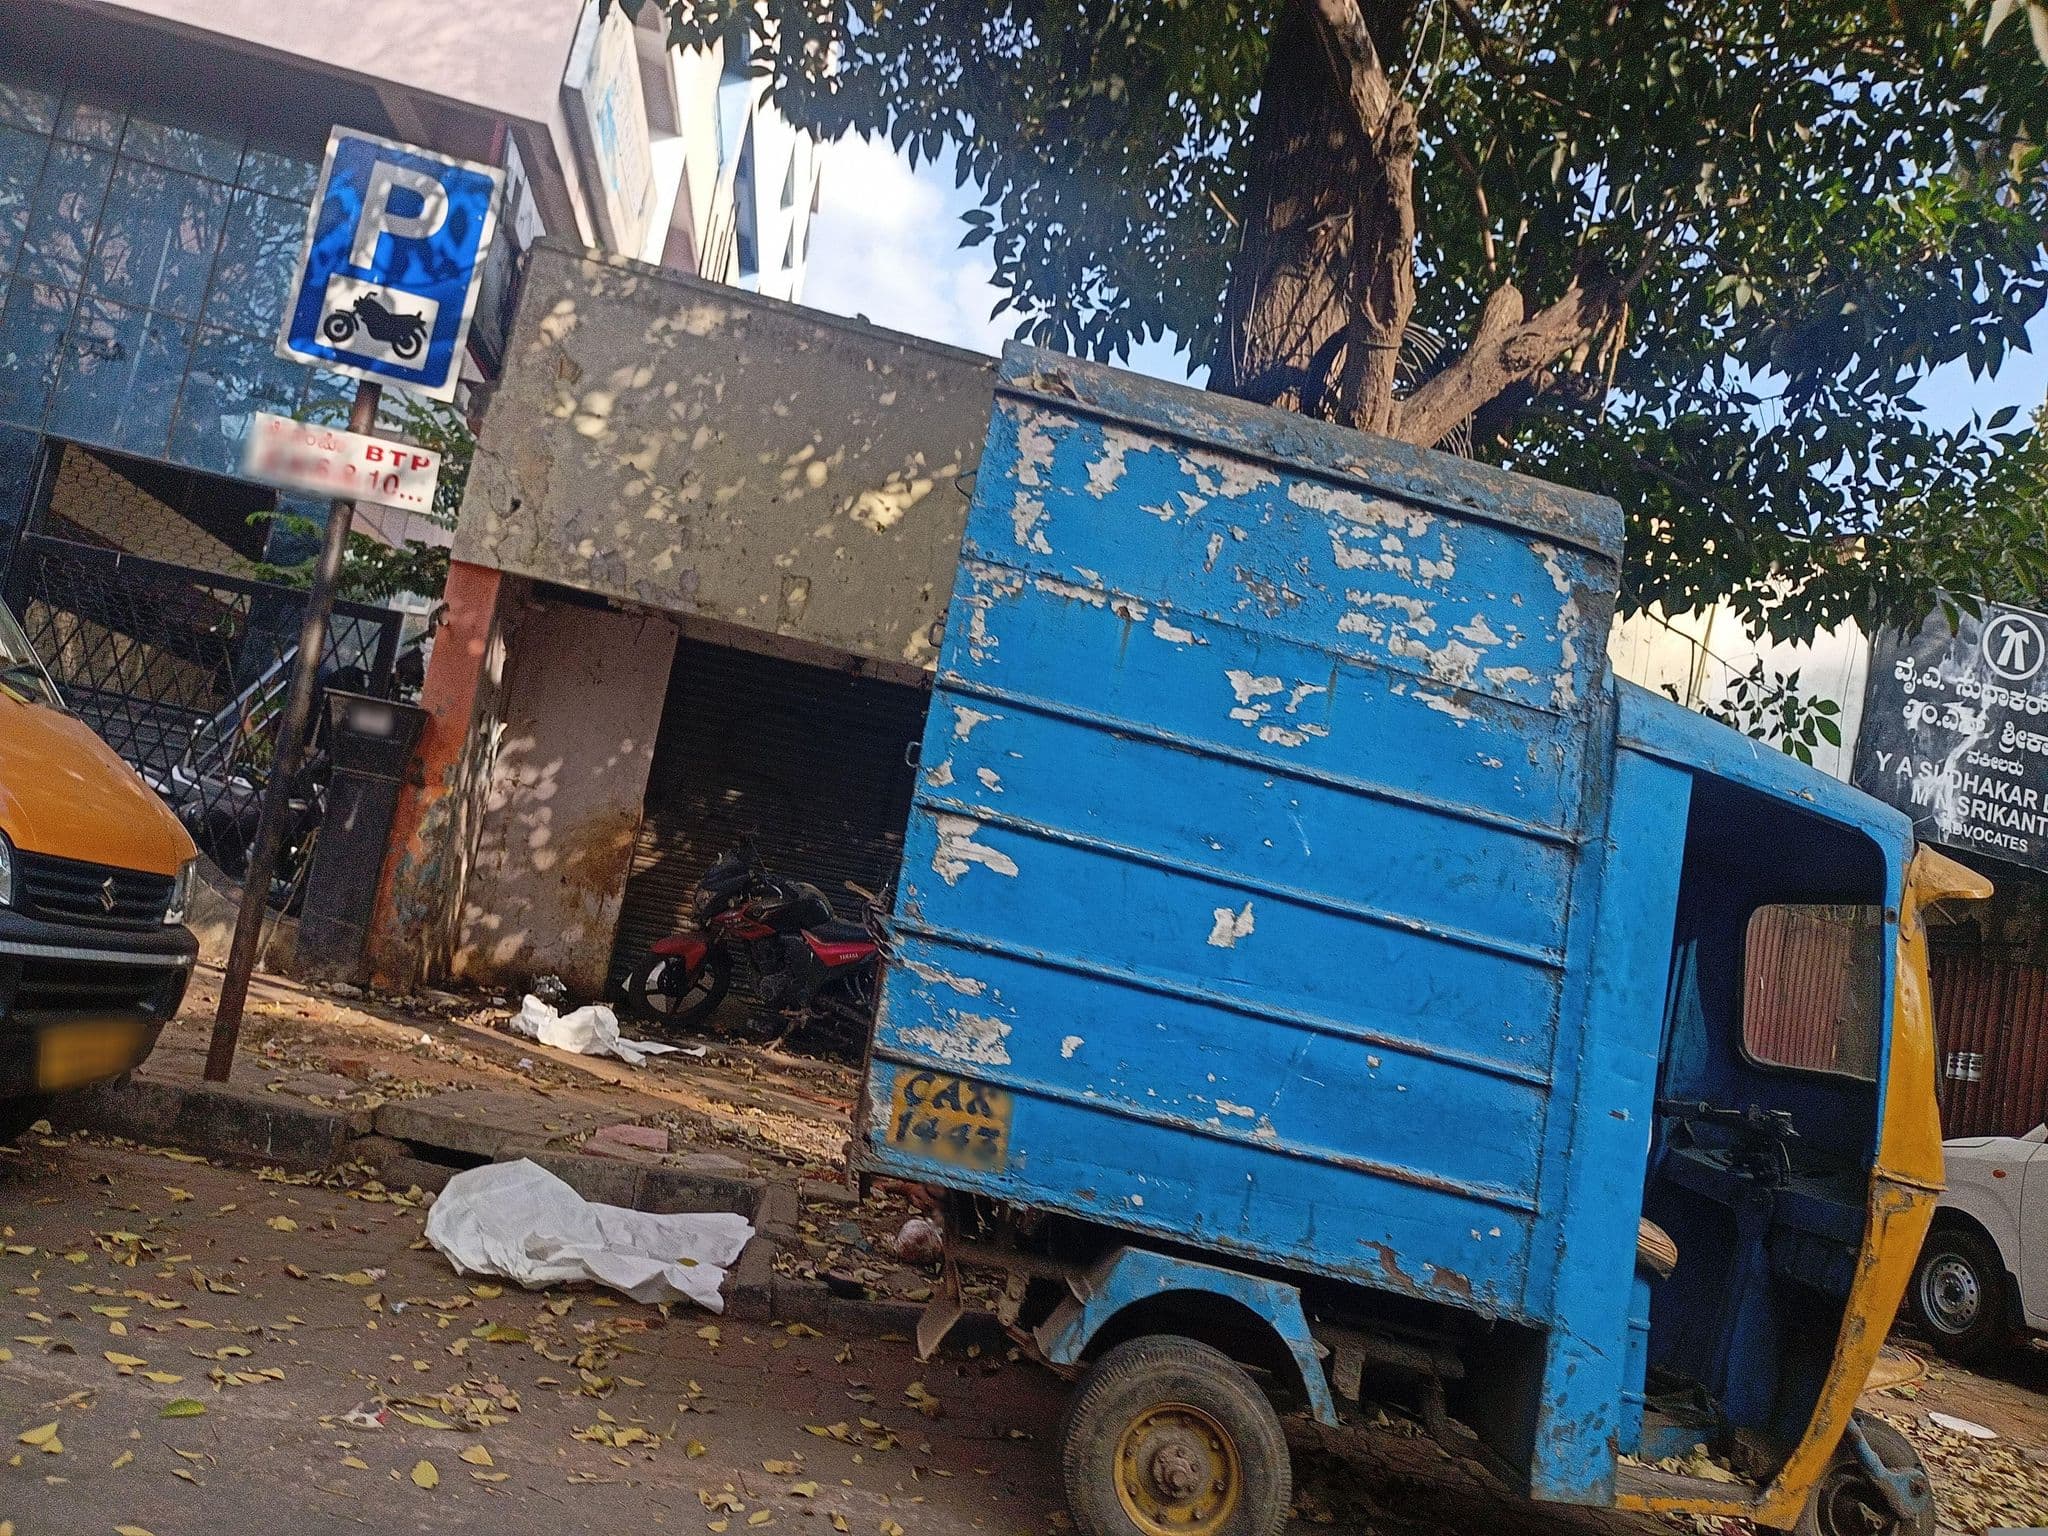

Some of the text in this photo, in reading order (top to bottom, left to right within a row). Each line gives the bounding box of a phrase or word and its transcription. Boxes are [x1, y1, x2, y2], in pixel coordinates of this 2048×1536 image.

[349, 160, 449, 271] P
[365, 445, 432, 471] BTP
[1876, 750, 1893, 772] Y
[1896, 756, 1913, 778] A
[1957, 795, 2048, 838] SRIKANT
